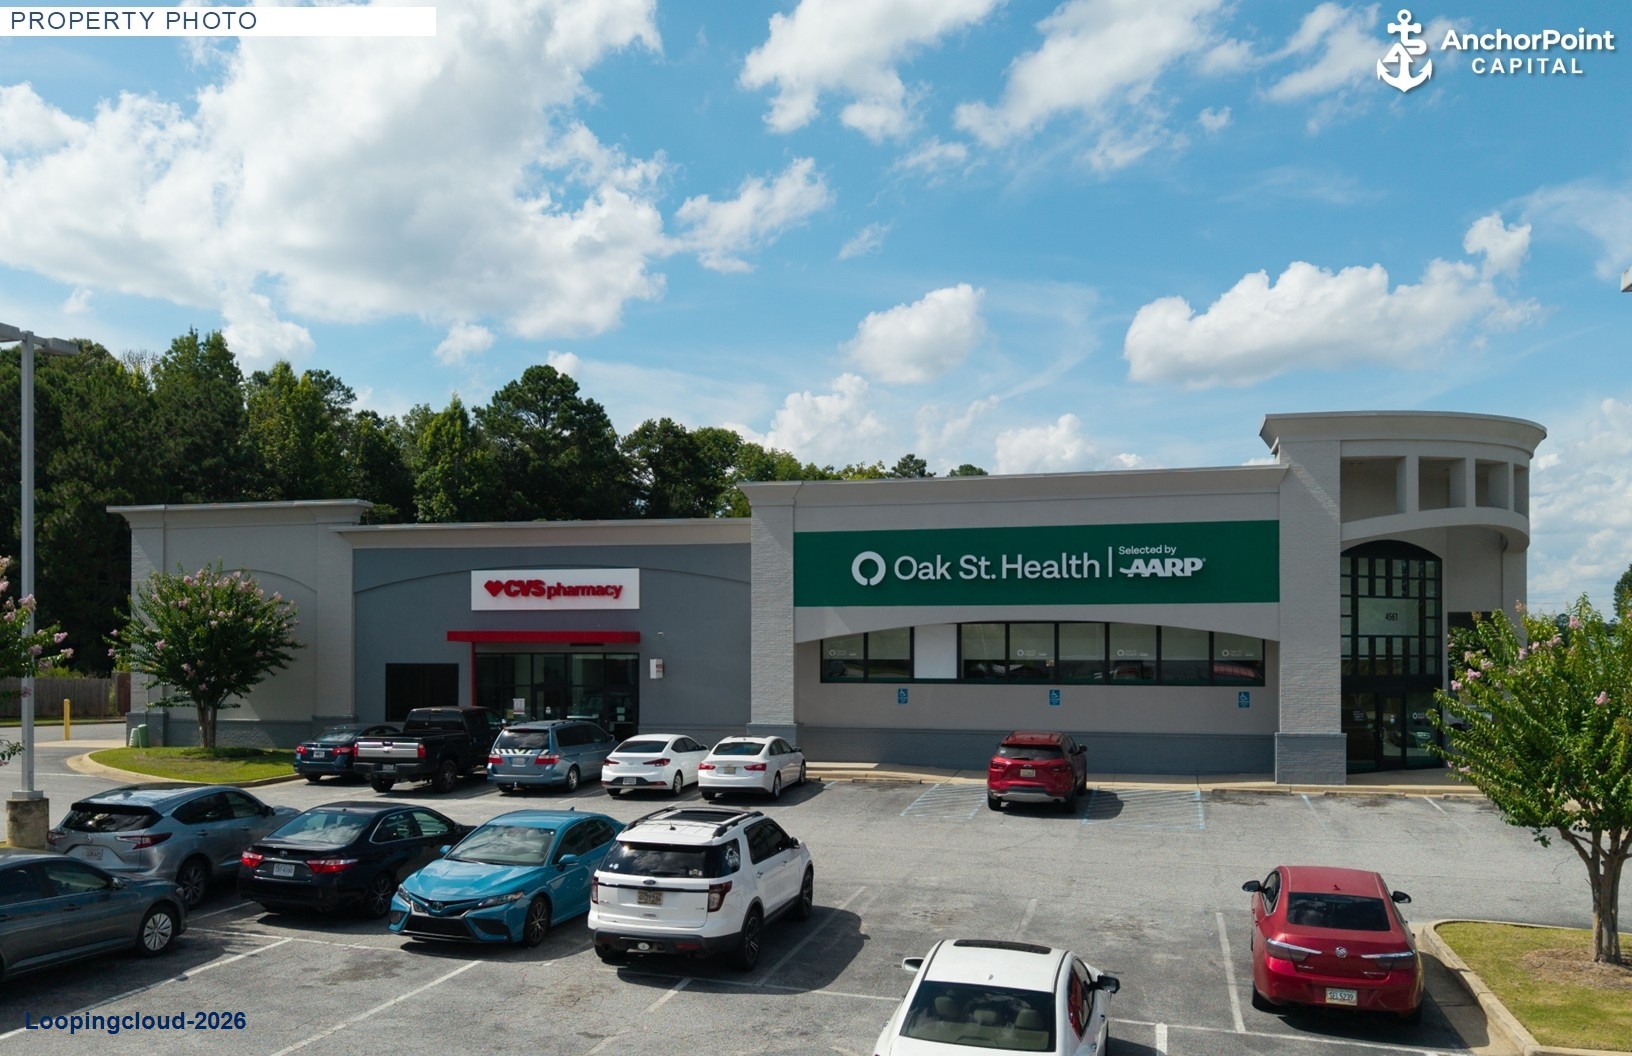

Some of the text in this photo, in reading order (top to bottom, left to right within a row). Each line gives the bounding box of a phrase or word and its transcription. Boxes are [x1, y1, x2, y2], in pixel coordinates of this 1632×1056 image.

[1118, 545, 1177, 555] Selected by
[894, 552, 1100, 580] Oak St. Health
[503, 579, 623, 600] CVS pharmacy
